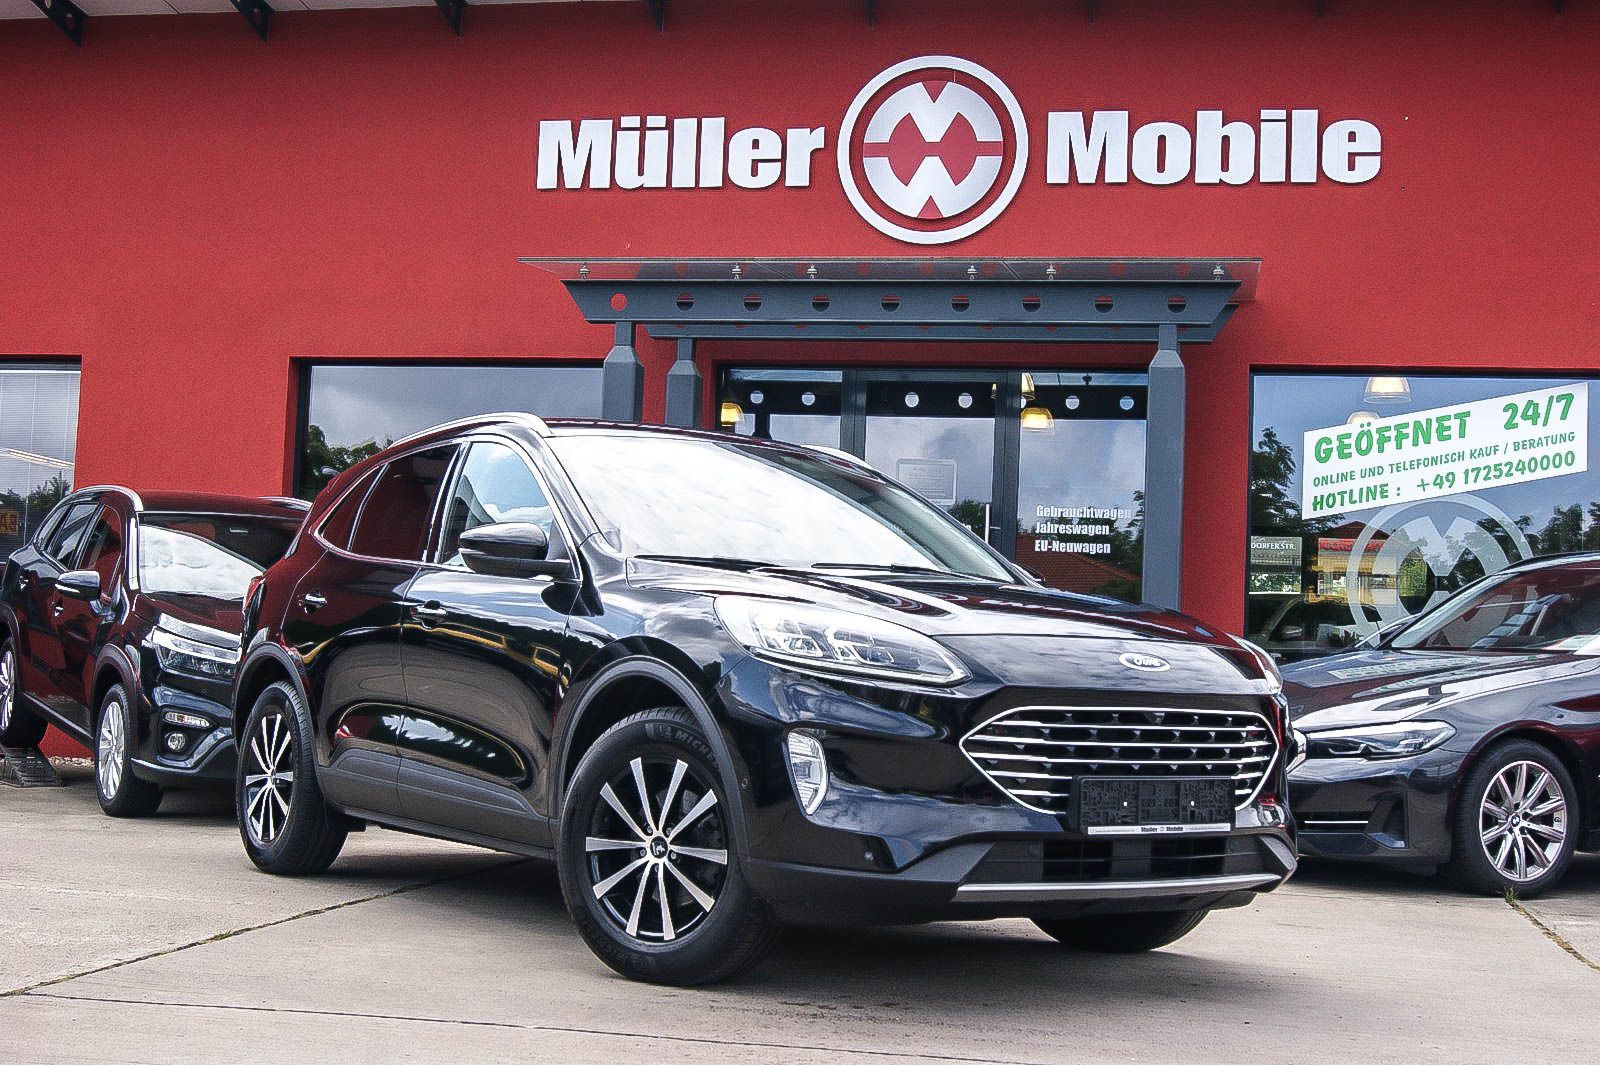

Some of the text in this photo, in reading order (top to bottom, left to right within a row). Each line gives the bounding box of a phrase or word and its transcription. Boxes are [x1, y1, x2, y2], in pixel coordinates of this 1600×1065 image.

[536, 109, 1382, 190] Müller Mobile
[1314, 392, 1575, 464] GEÖFFNET 24/7
[1312, 483, 1389, 511] HOTLINE
[1416, 471, 1456, 493] +49
[1463, 450, 1576, 485] 1725240000
[1313, 431, 1576, 487] ONLINE UND TELEFONISCH KAUF / BERATUNG
[1035, 521, 1110, 537] Jahreswagen
[1036, 505, 1134, 521] Gebrauchtwagen
[1034, 539, 1111, 555] EU-Neuwagen
